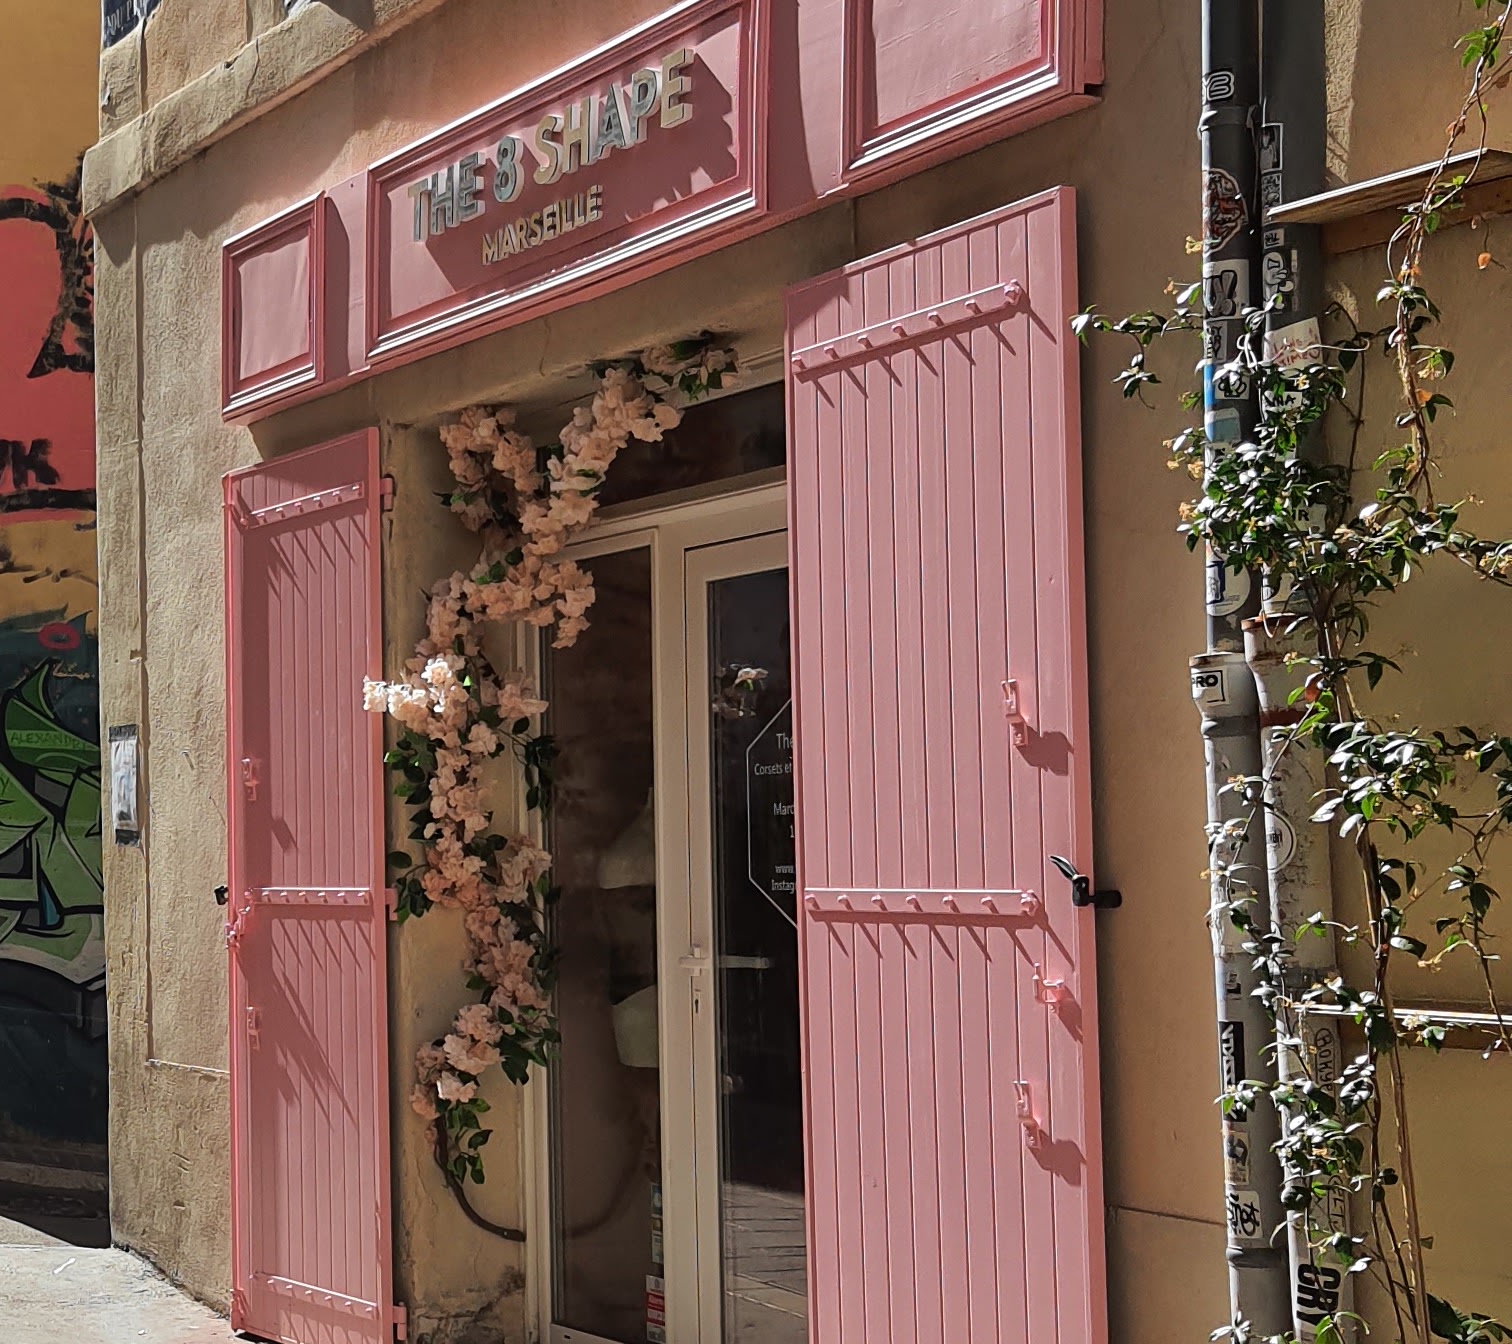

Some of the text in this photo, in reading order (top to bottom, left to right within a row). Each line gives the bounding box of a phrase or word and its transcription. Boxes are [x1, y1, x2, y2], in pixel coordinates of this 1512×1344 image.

[407, 47, 694, 243] THE 8 SHAPE
[482, 184, 603, 265] MARSEILLE
[754, 763, 783, 776] Corsets
